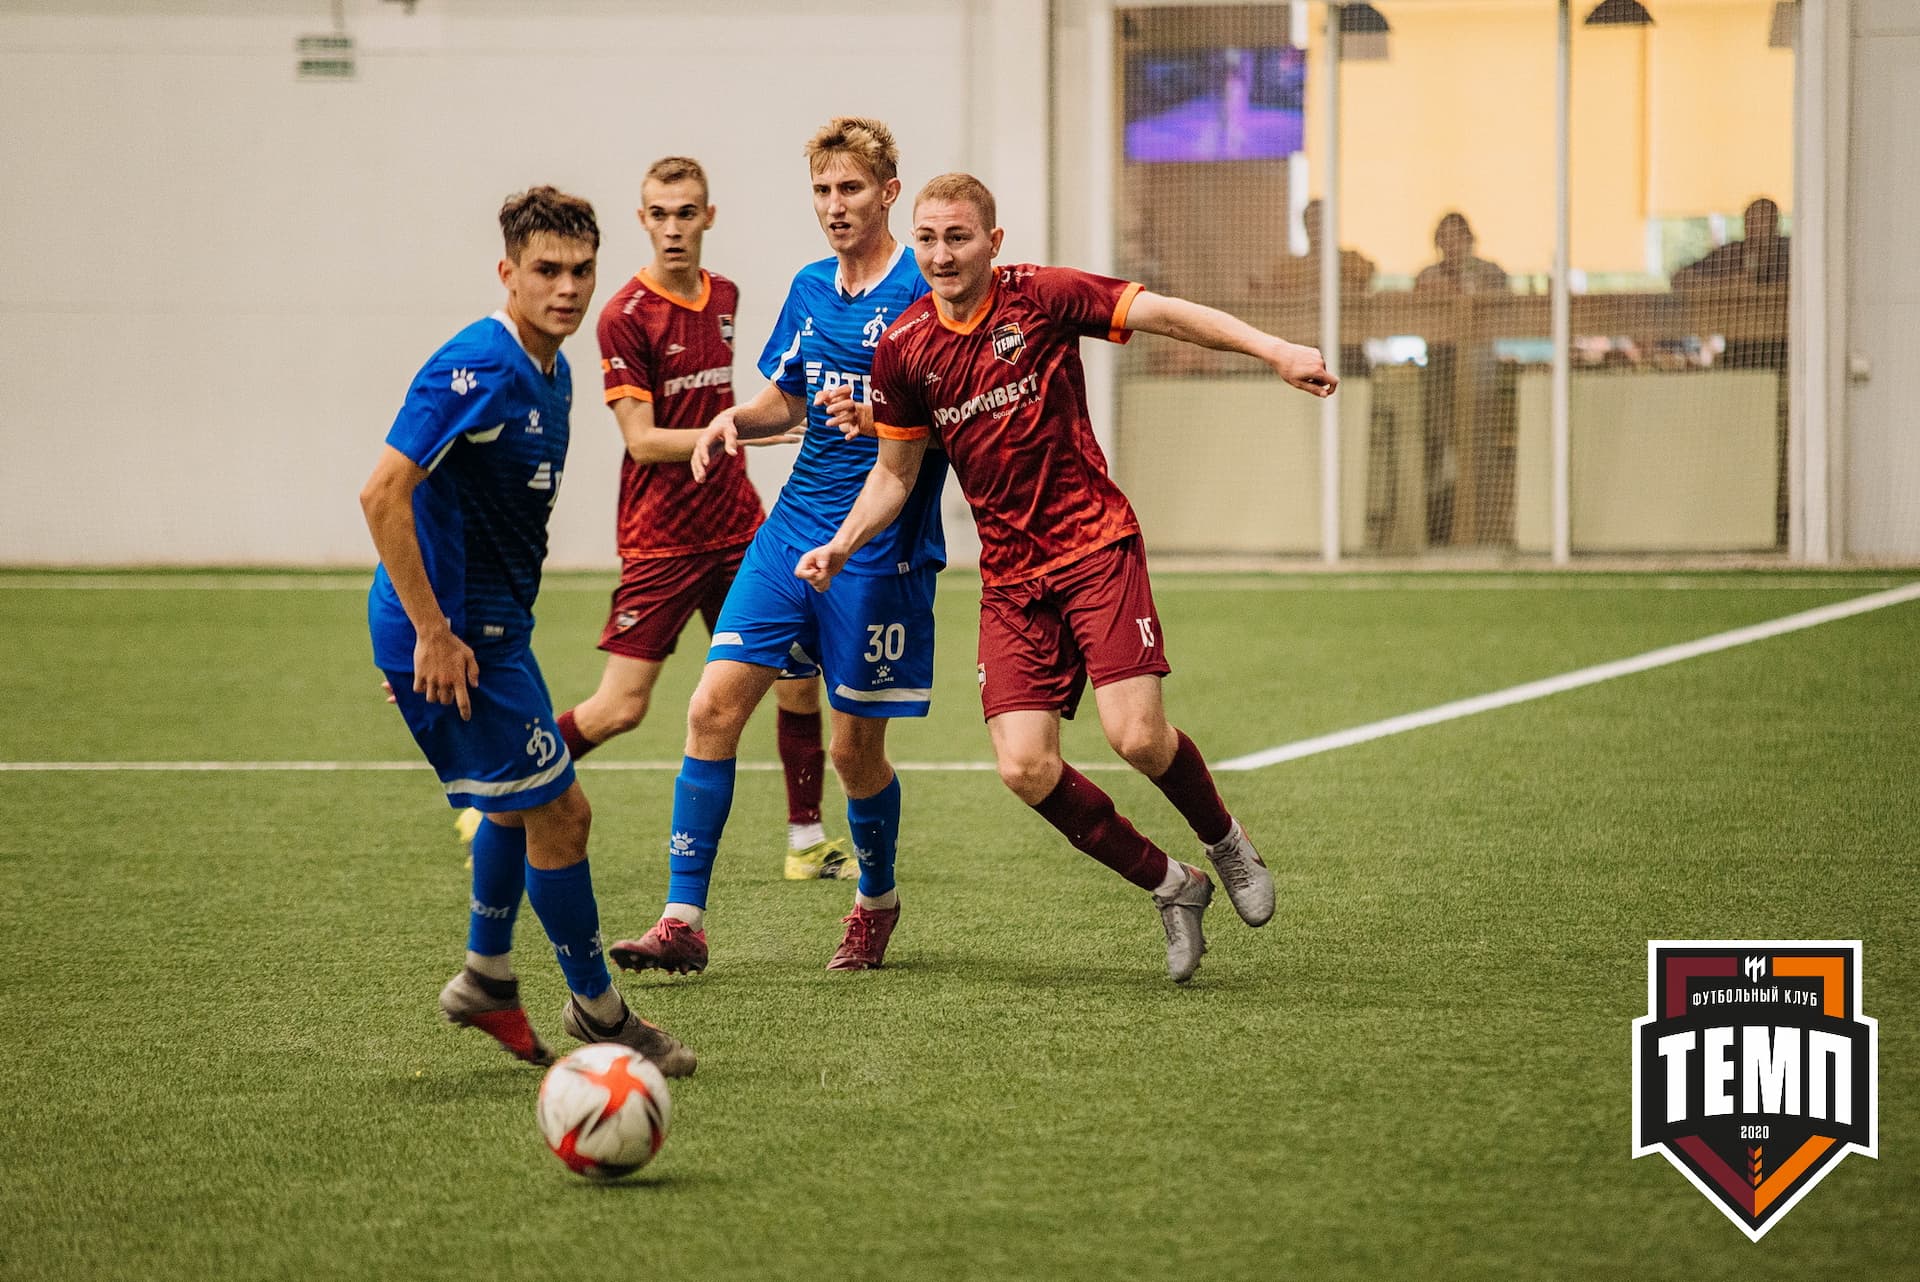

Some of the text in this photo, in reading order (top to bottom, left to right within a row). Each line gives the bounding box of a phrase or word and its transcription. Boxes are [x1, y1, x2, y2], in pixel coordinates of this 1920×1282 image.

[996, 334, 1022, 354] ТЕМП
[864, 623, 906, 662] 30
[1136, 617, 1155, 648] 15
